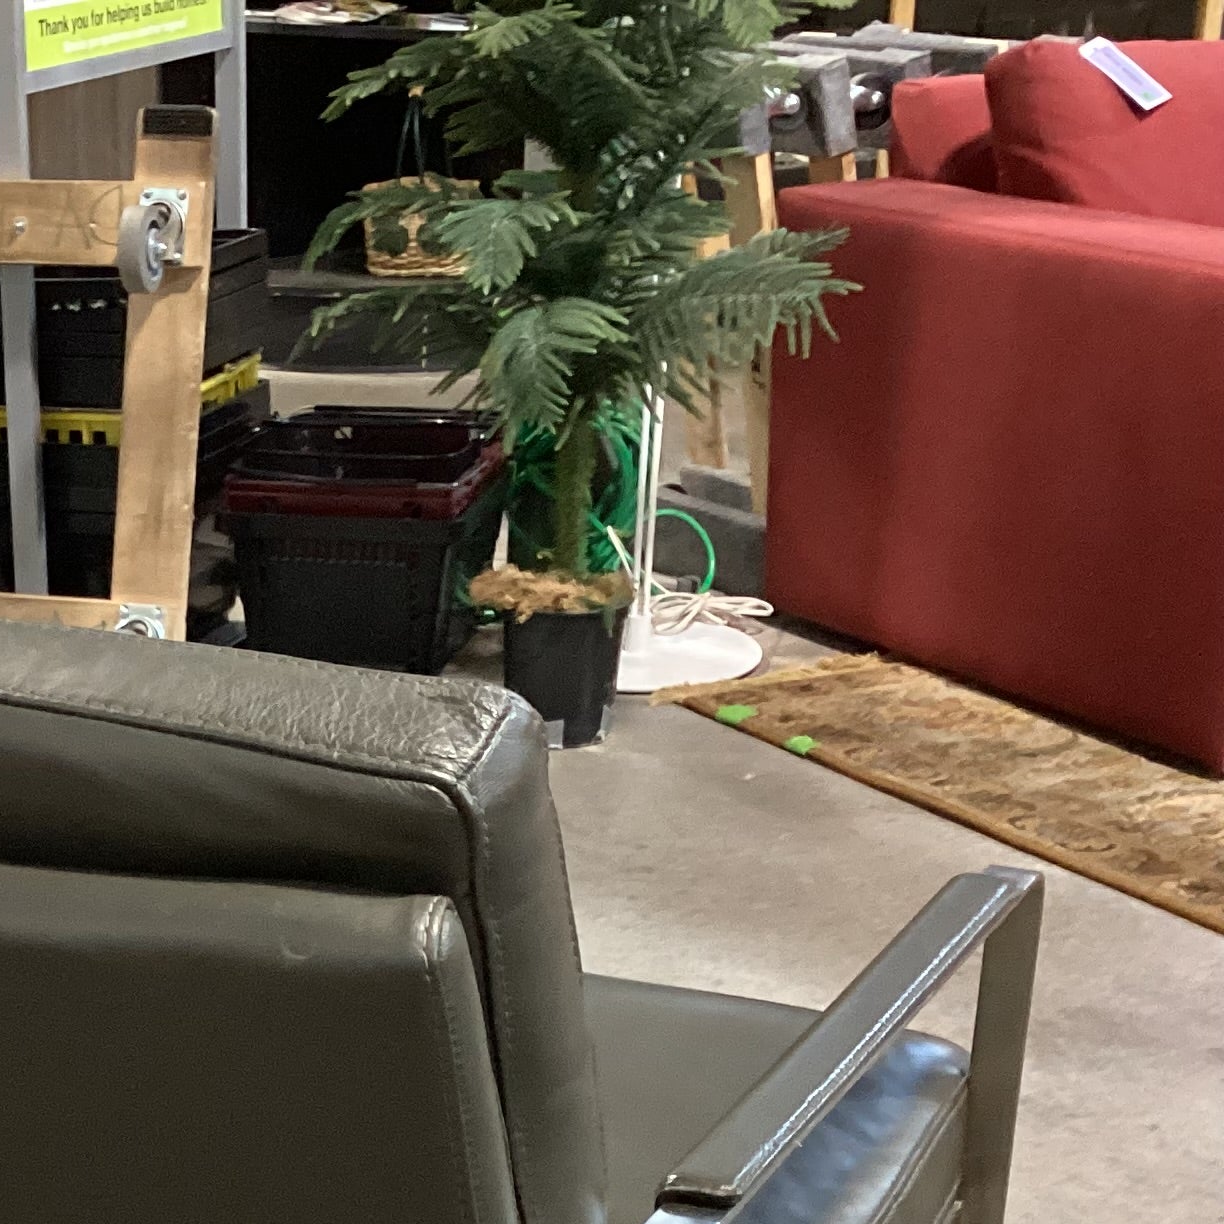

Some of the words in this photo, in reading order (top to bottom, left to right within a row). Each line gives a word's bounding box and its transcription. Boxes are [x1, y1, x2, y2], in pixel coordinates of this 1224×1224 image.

[38, 15, 69, 37] Thank
[71, 15, 89, 35] you
[91, 8, 104, 28] for
[106, 4, 140, 25] helping
[141, 3, 152, 17] us
